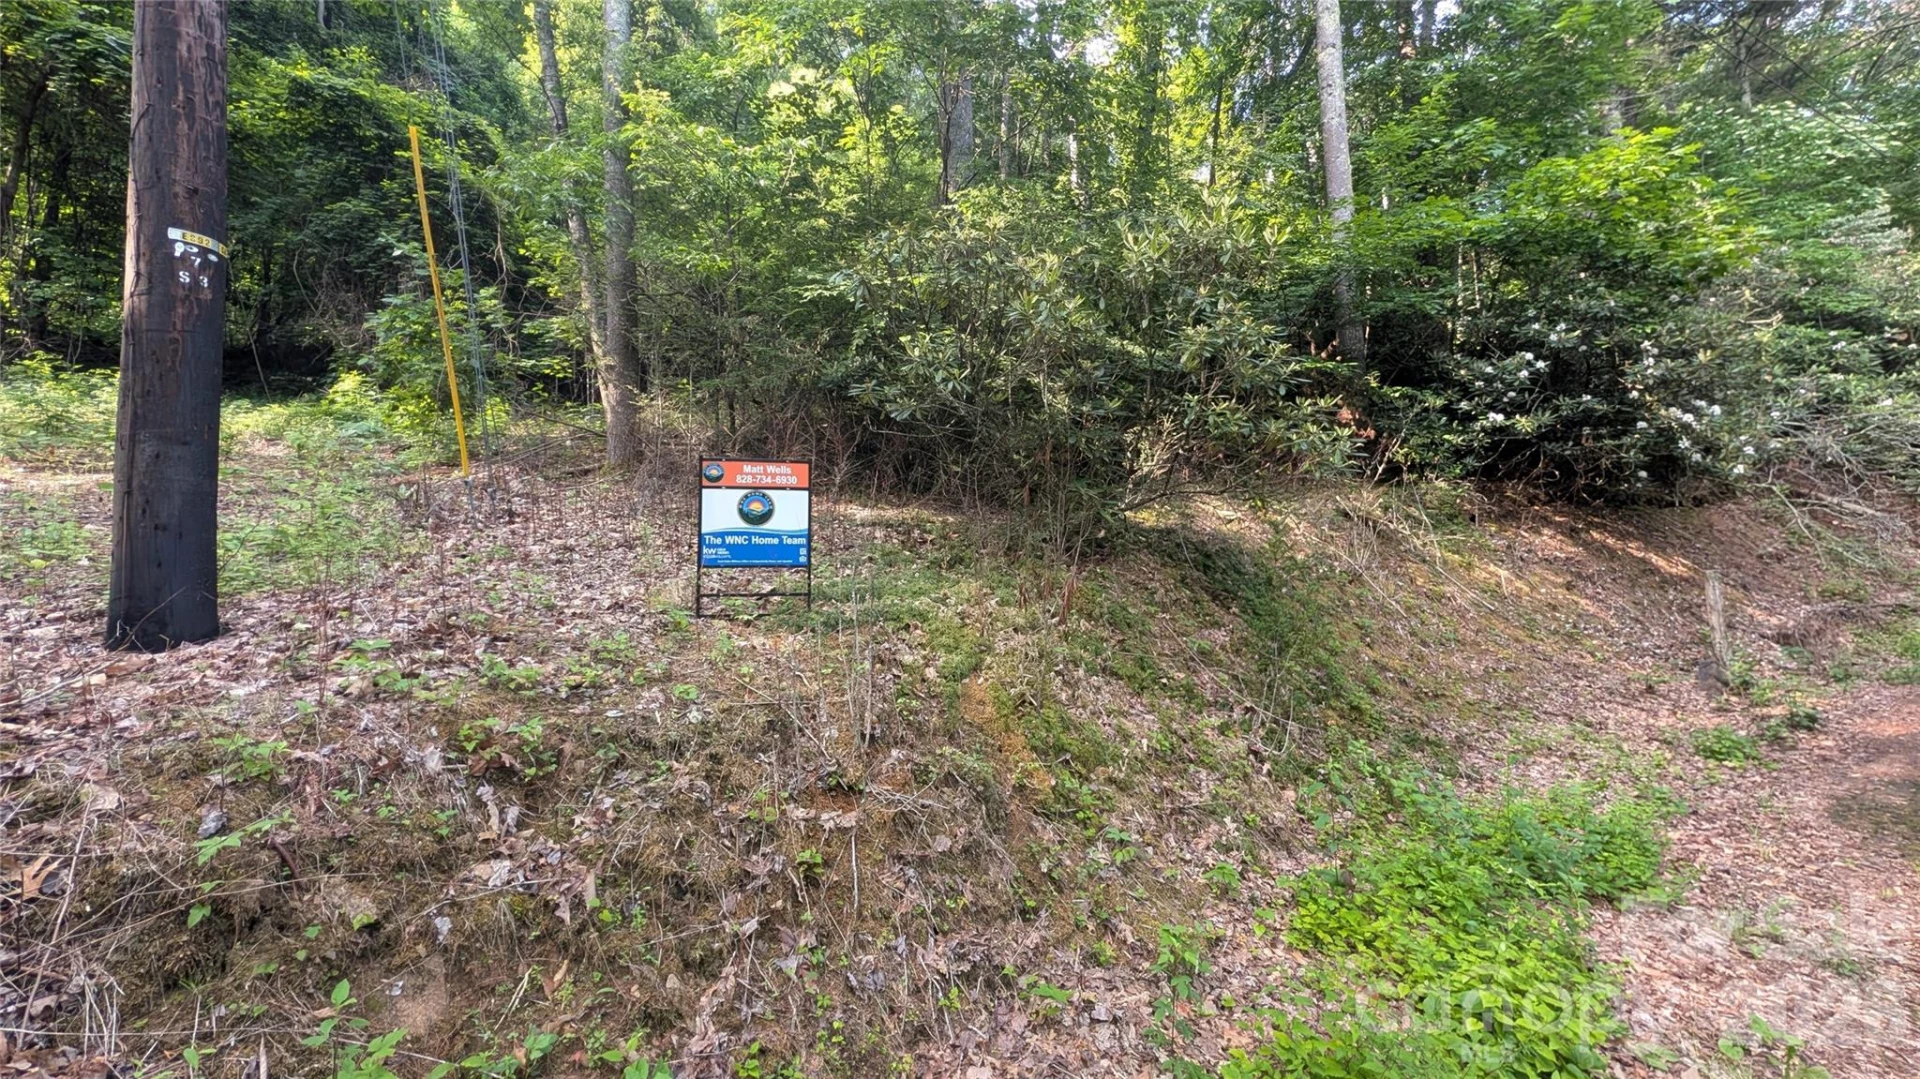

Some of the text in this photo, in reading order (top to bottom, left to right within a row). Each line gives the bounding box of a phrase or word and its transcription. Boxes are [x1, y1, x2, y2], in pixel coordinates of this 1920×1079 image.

[743, 465, 791, 474] Matt Wells
[735, 475, 797, 484] 828-734-6930
[704, 535, 806, 545] The WNC Home Team
[703, 546, 717, 555] kw
